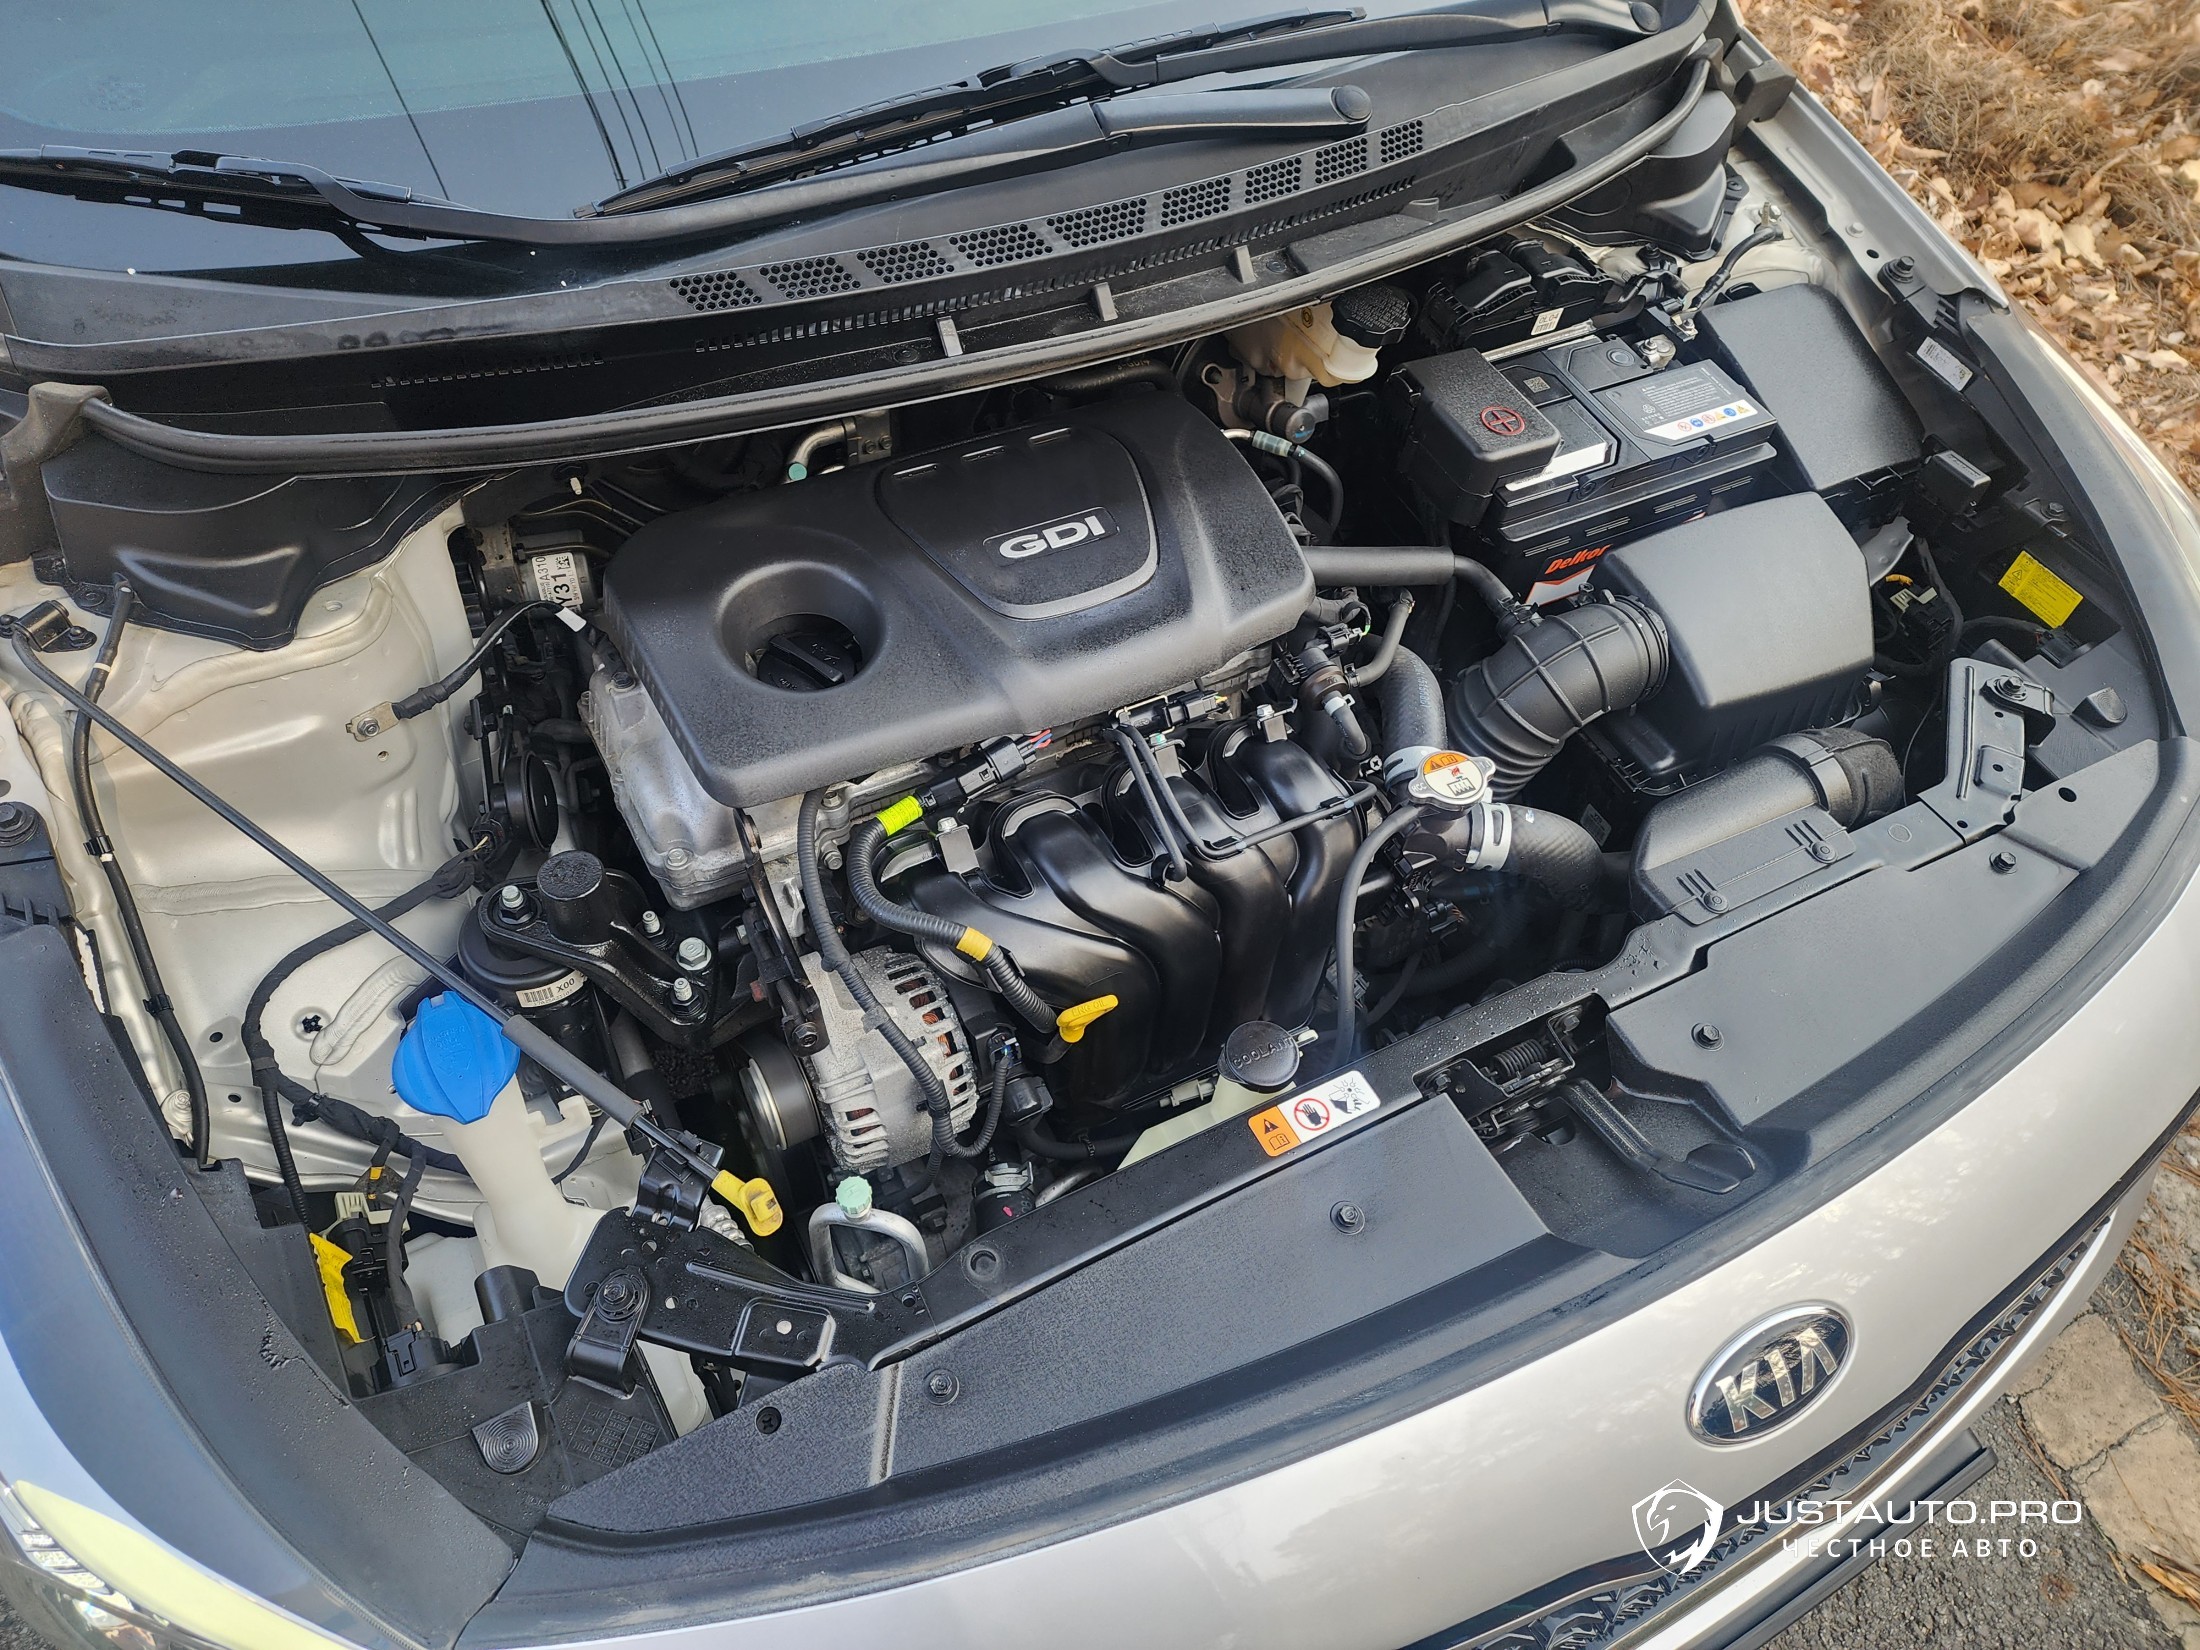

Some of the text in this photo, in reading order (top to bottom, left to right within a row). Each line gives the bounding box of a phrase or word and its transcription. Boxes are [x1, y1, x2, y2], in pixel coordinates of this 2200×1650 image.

[1000, 515, 1106, 559] GDI
[1544, 543, 1614, 575] Delkor
[550, 573, 573, 606] Y31
[1233, 1035, 1295, 1069] COOLANT
[1714, 1327, 1838, 1433] KIA
